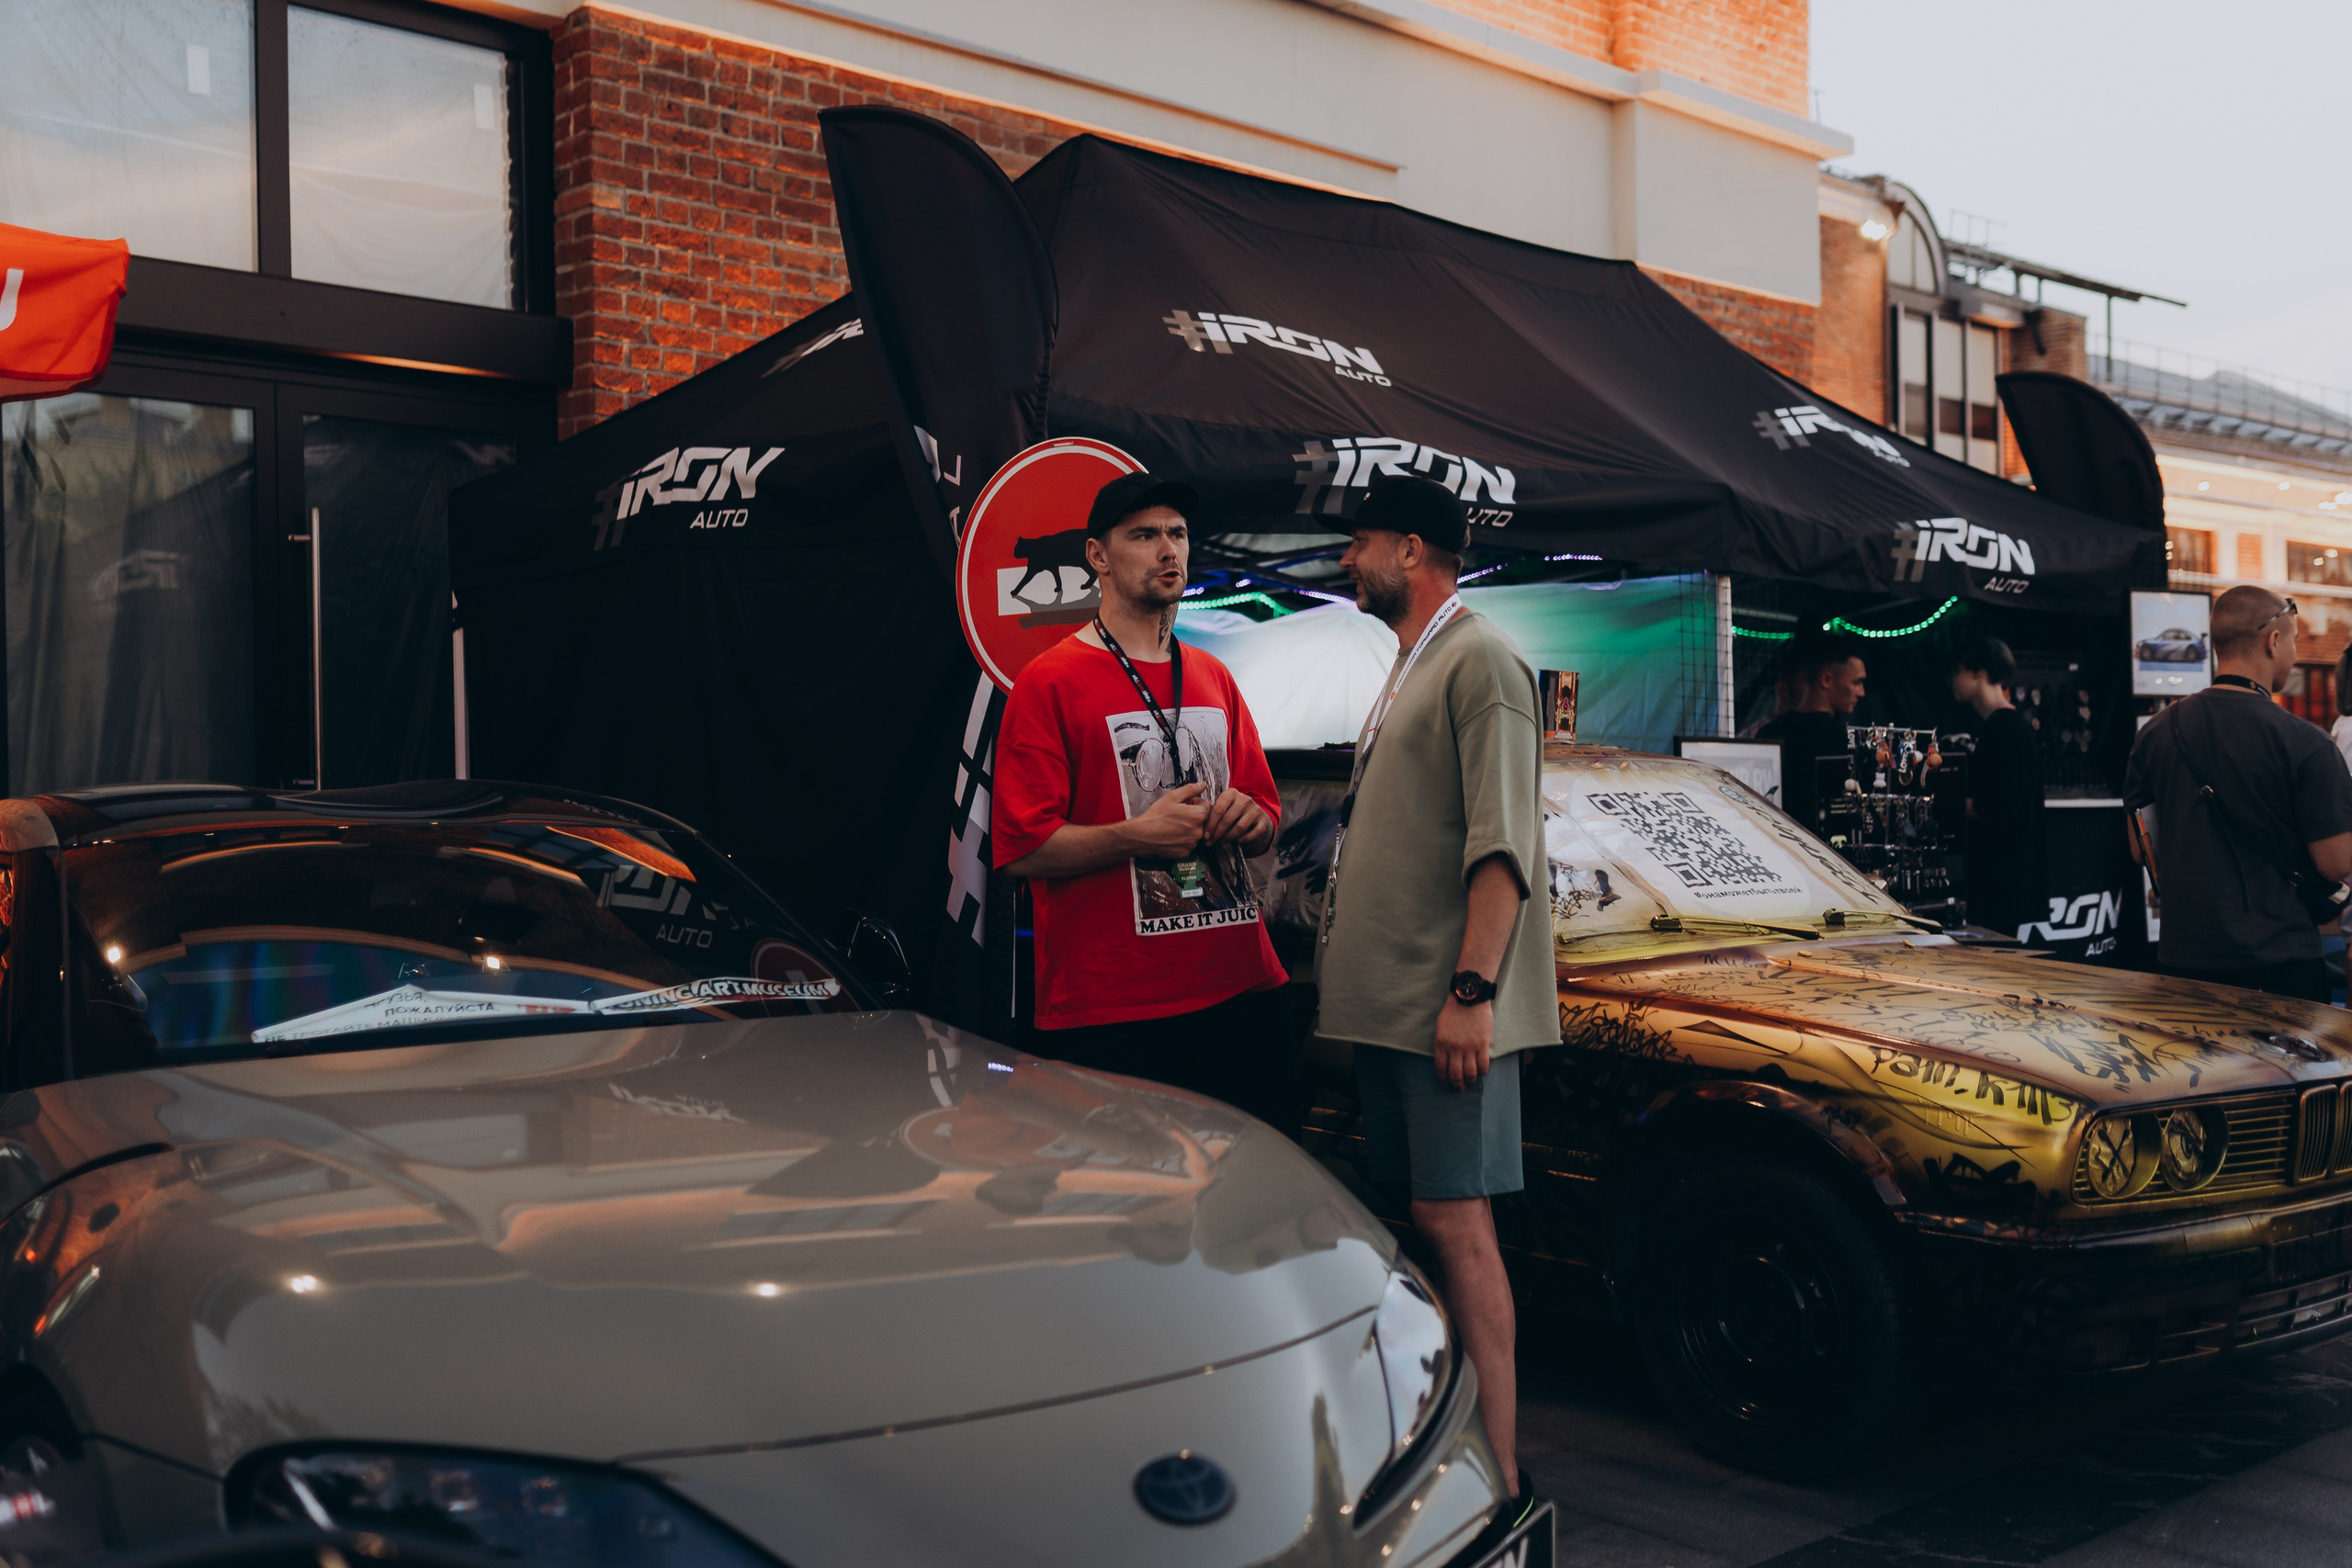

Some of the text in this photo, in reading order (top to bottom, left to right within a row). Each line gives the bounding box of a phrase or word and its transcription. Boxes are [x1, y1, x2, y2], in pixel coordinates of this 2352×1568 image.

[1335, 366, 1392, 387] AUTO
[690, 509, 749, 529] AUTO
[1466, 507, 1513, 527] UTO
[1984, 576, 2030, 593] AUTO
[1139, 907, 1258, 934] MAKE IT JUIC
